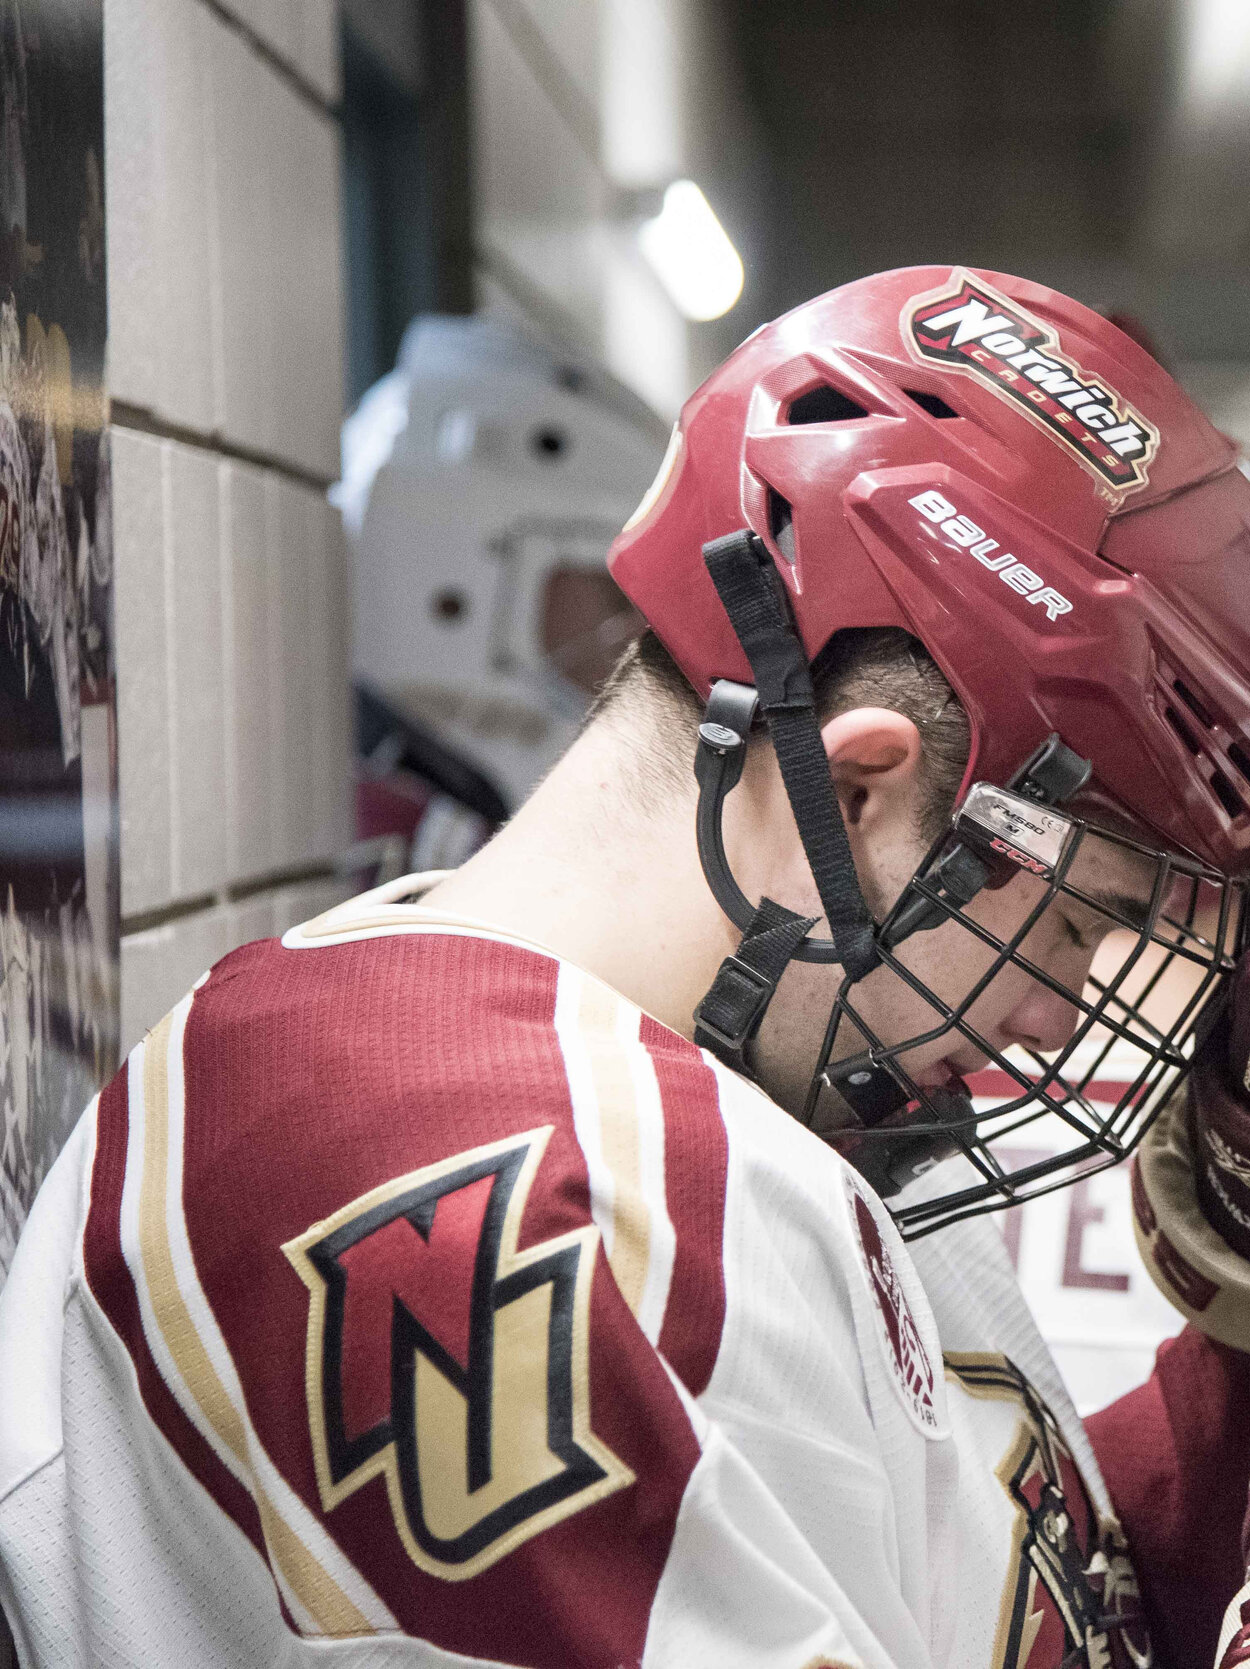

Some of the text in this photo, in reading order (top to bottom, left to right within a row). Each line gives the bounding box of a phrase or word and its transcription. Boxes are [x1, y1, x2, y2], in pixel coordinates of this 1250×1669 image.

[922, 299, 1146, 457] Norwich
[970, 349, 1120, 468] CADETS
[990, 836, 1048, 874] CCM
